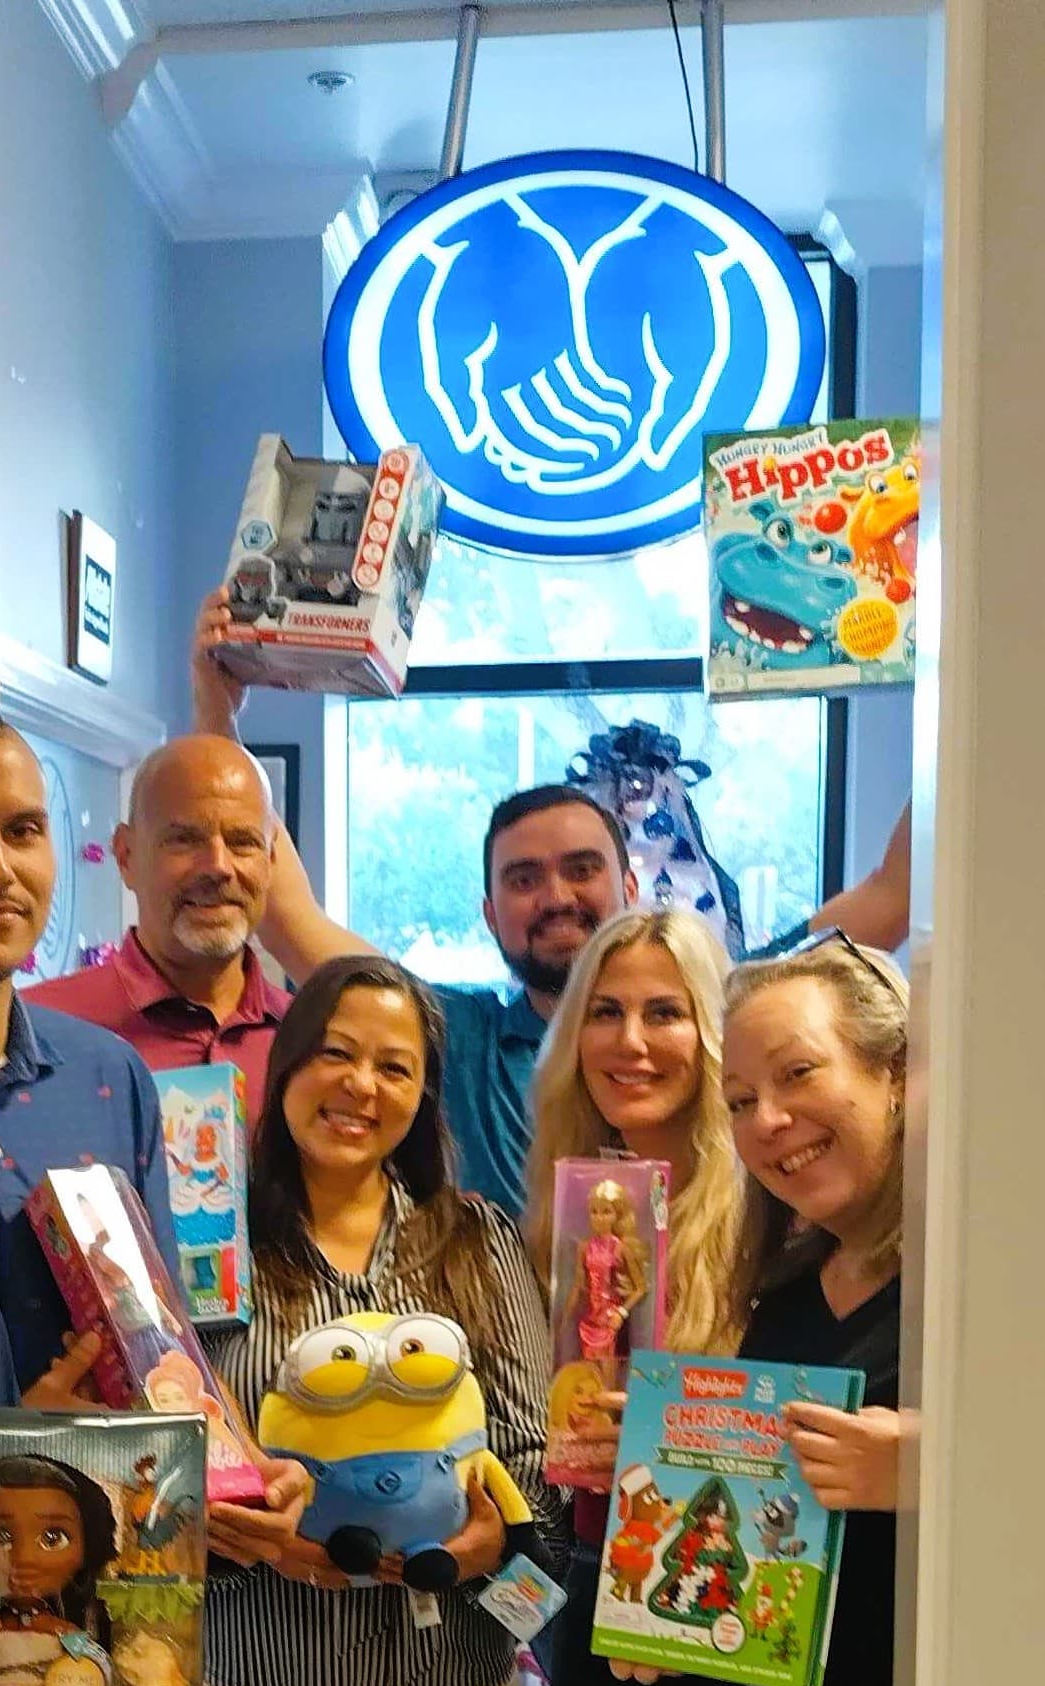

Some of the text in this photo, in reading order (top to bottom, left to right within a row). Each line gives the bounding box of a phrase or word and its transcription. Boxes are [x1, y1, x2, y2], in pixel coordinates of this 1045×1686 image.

[717, 432, 824, 466] HUNGRY HUNGRY
[725, 436, 889, 502] Hippos
[287, 612, 370, 633] TRANSFORMERS
[683, 1371, 744, 1398] Highlights
[664, 1403, 781, 1438] CHRISTMA
[664, 1428, 722, 1450] PUZZLE
[741, 1437, 781, 1458] PLAY
[712, 1457, 737, 1472] 100
